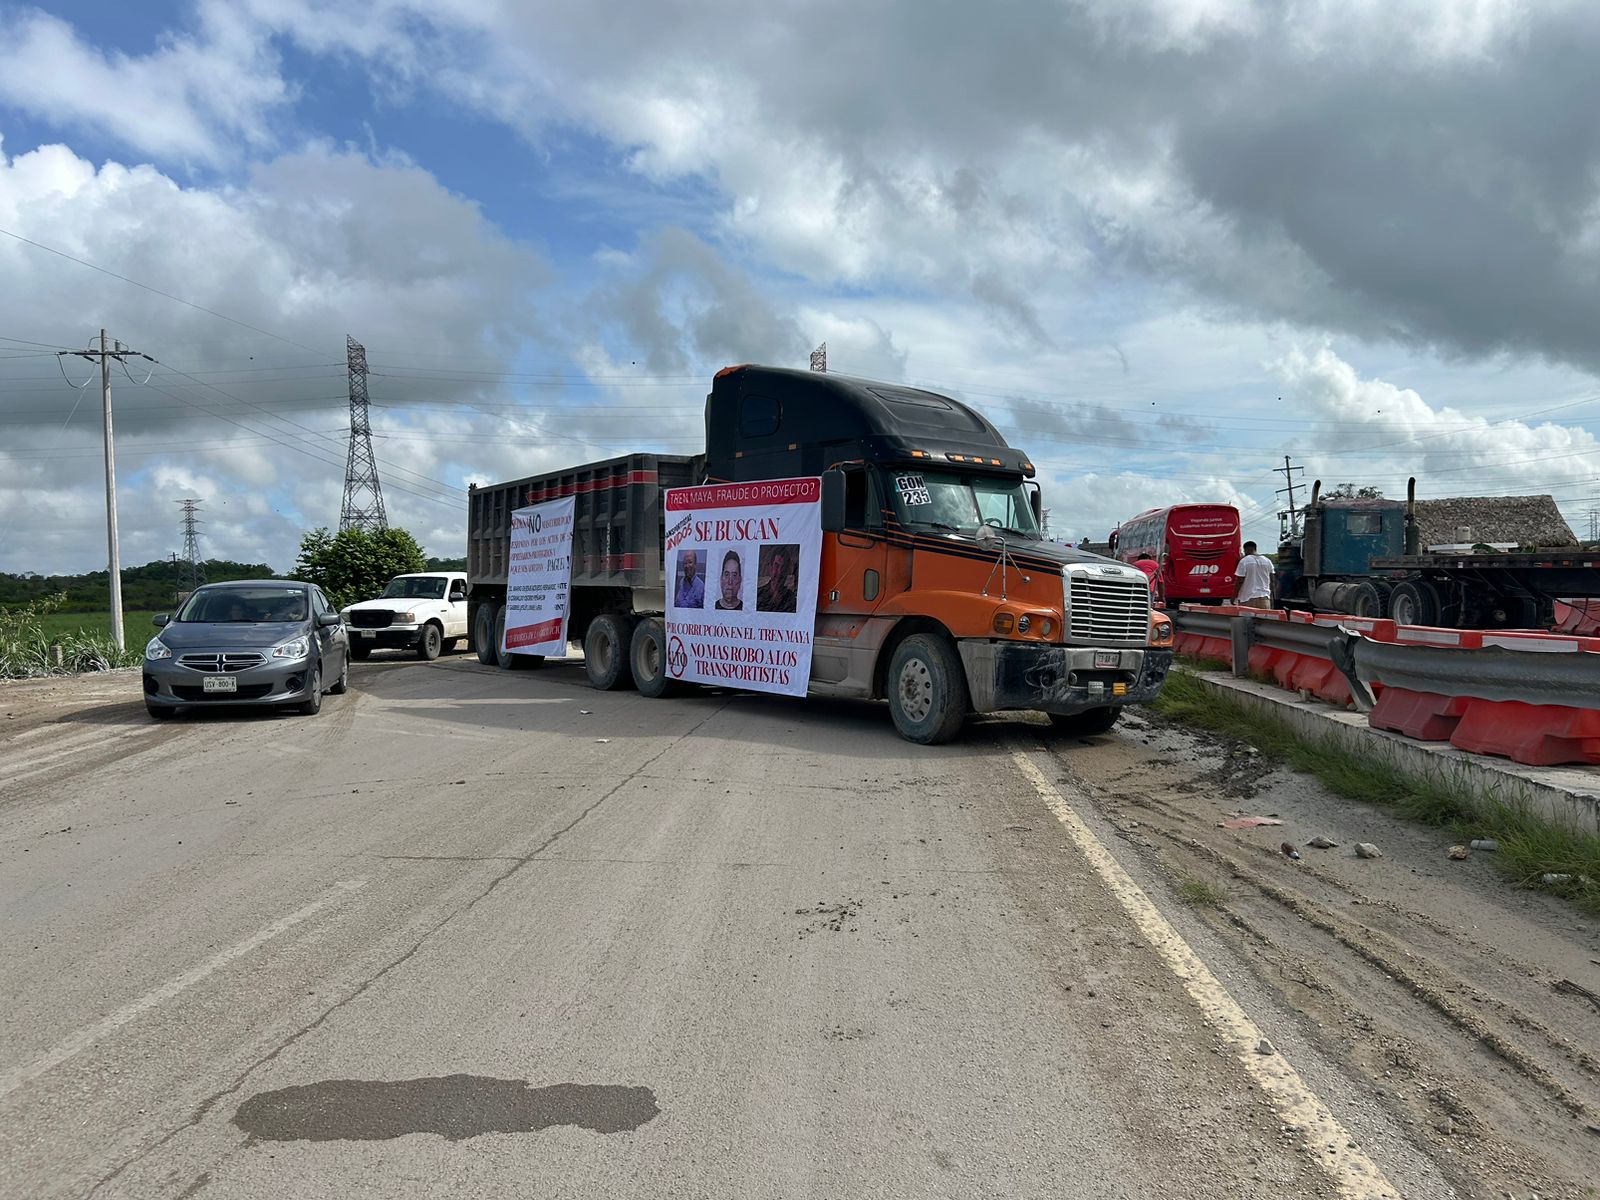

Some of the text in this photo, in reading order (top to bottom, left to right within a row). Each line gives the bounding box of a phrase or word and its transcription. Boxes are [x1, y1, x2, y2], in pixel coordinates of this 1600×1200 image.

[670, 493, 689, 505] TREN
[717, 487, 749, 502] FRAUDE
[752, 486, 759, 499] O
[760, 482, 815, 498] PROYECTO?
[897, 477, 925, 490] GON
[904, 490, 930, 505] 235
[528, 514, 542, 534] NO
[695, 517, 781, 542] SE BUSCAN
[1188, 564, 1220, 575] ADO
[677, 623, 730, 638] CORRUPCIÓN
[730, 627, 744, 639] EN
[744, 628, 756, 640] EL
[758, 628, 784, 642] TREN
[785, 630, 810, 644] MAYA
[690, 643, 706, 658] NO
[707, 644, 730, 660] MAS
[730, 646, 765, 664] ROBO
[765, 650, 774, 665] A
[775, 650, 798, 667] LOS
[695, 660, 790, 686] TRANSPORTISTAS
